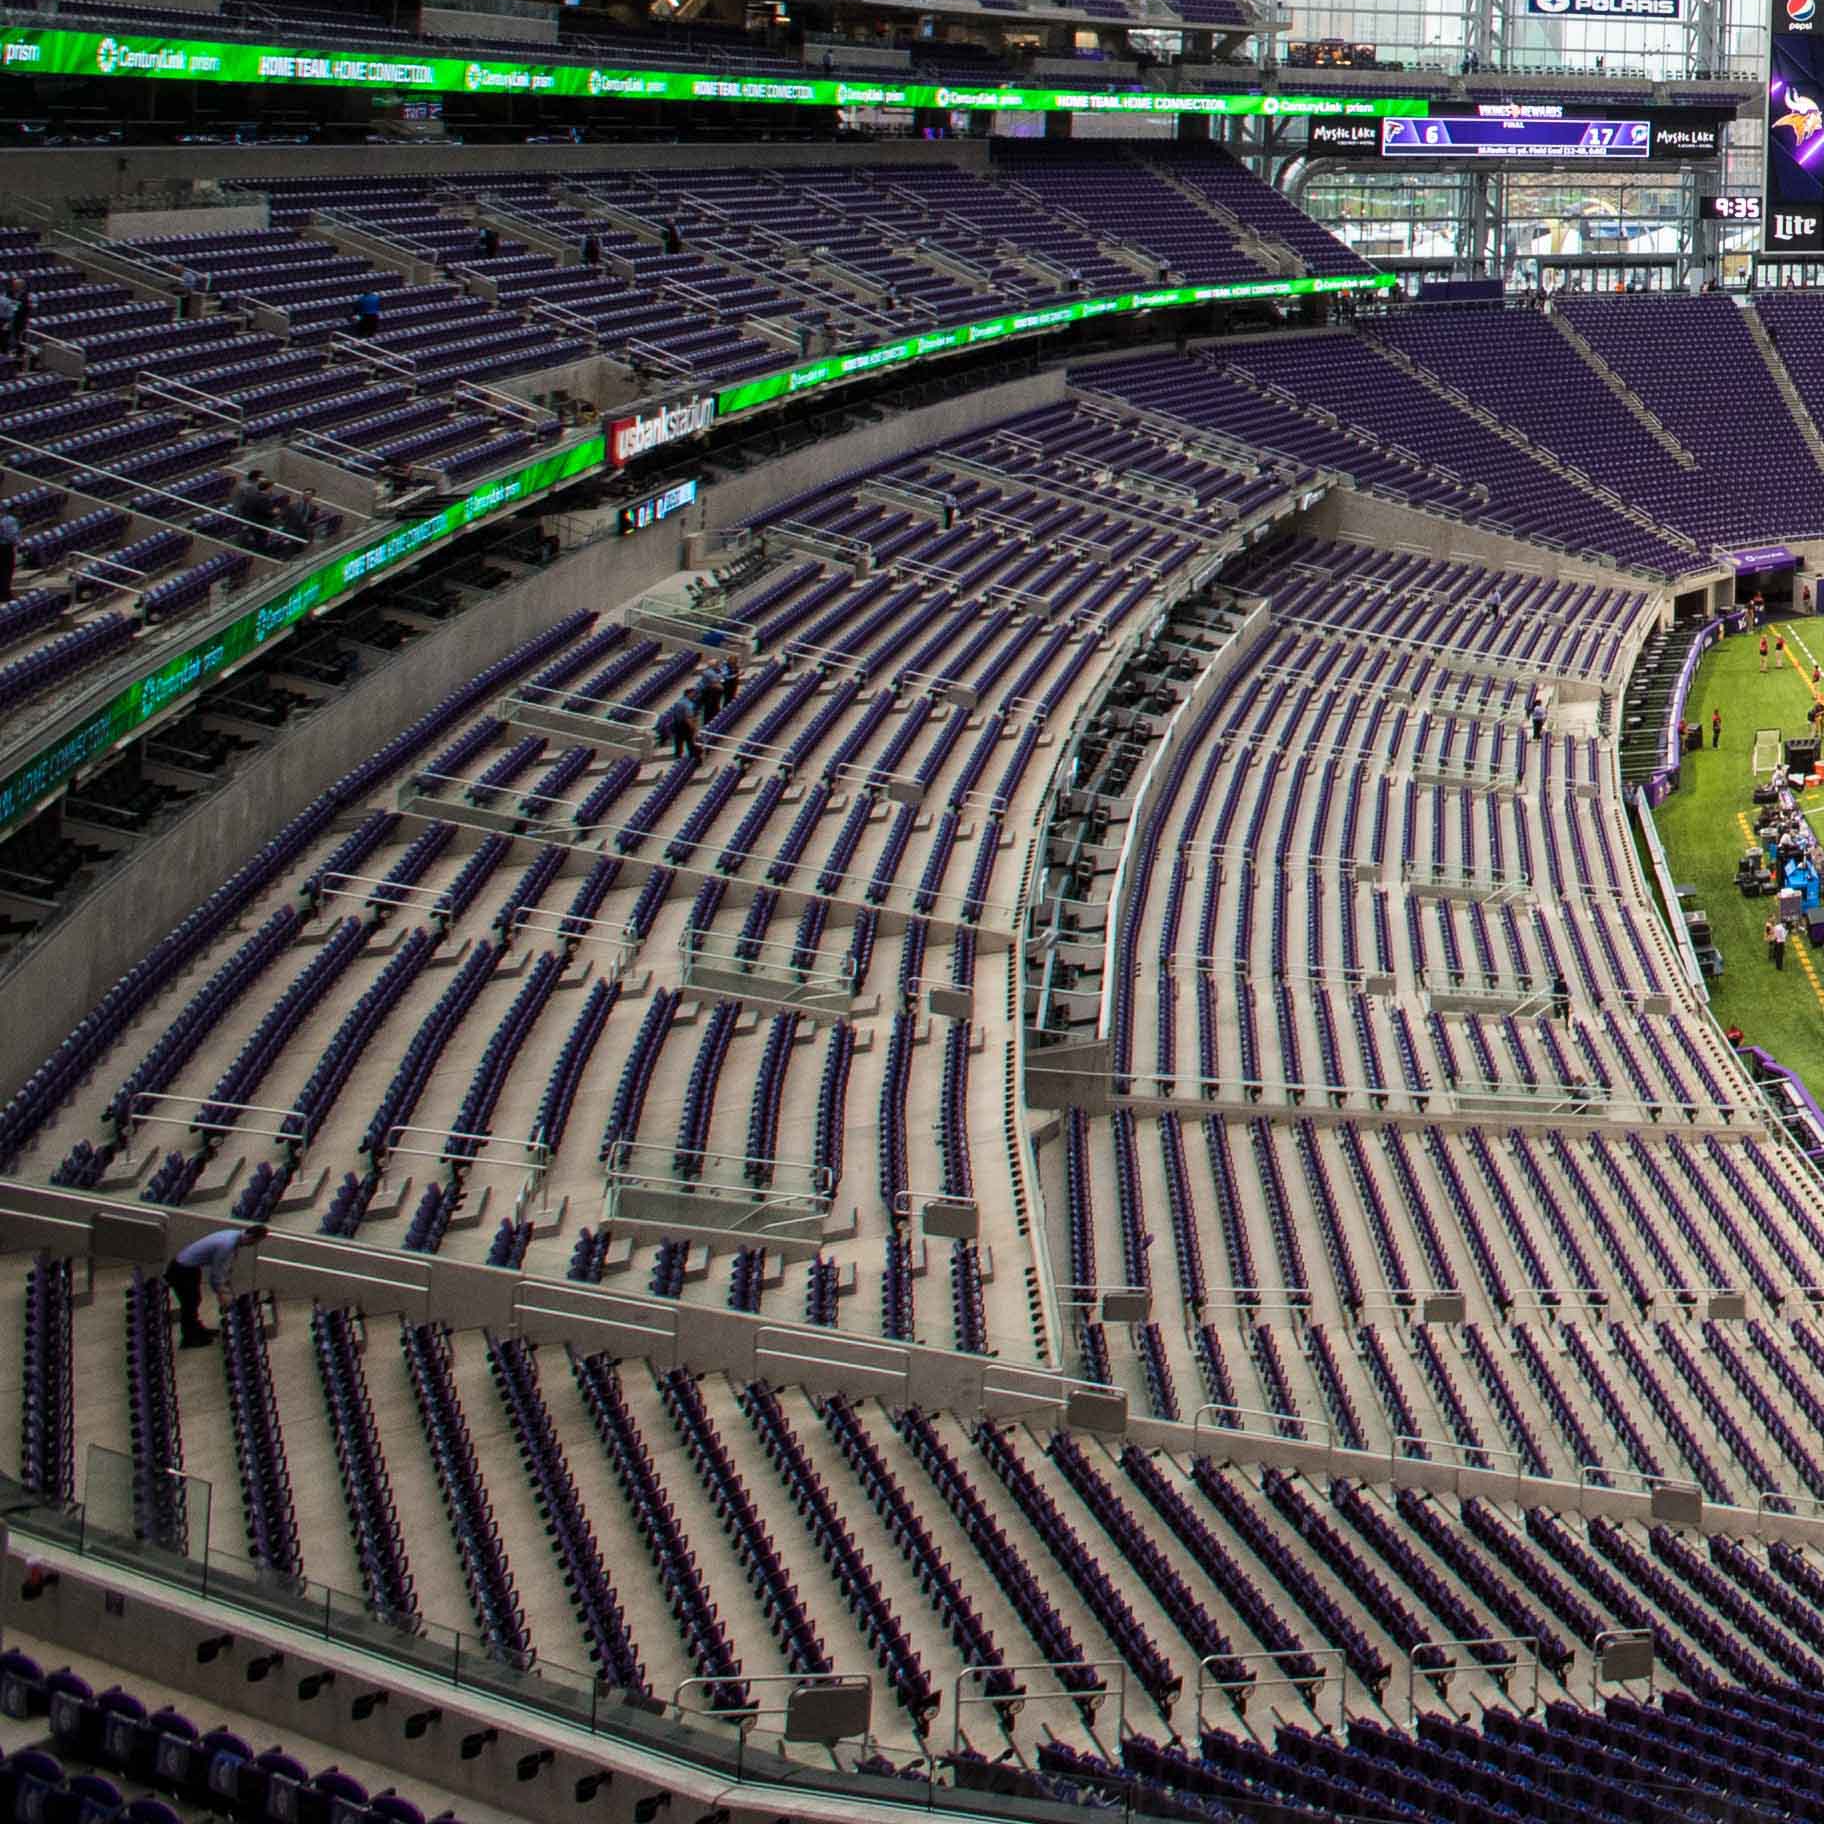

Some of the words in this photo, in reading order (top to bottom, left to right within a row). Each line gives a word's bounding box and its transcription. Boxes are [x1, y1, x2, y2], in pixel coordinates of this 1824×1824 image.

[1425, 126, 1438, 144] 6
[1589, 127, 1613, 146] 17
[1715, 198, 1759, 218] 9:35
[1774, 214, 1817, 240] Lite
